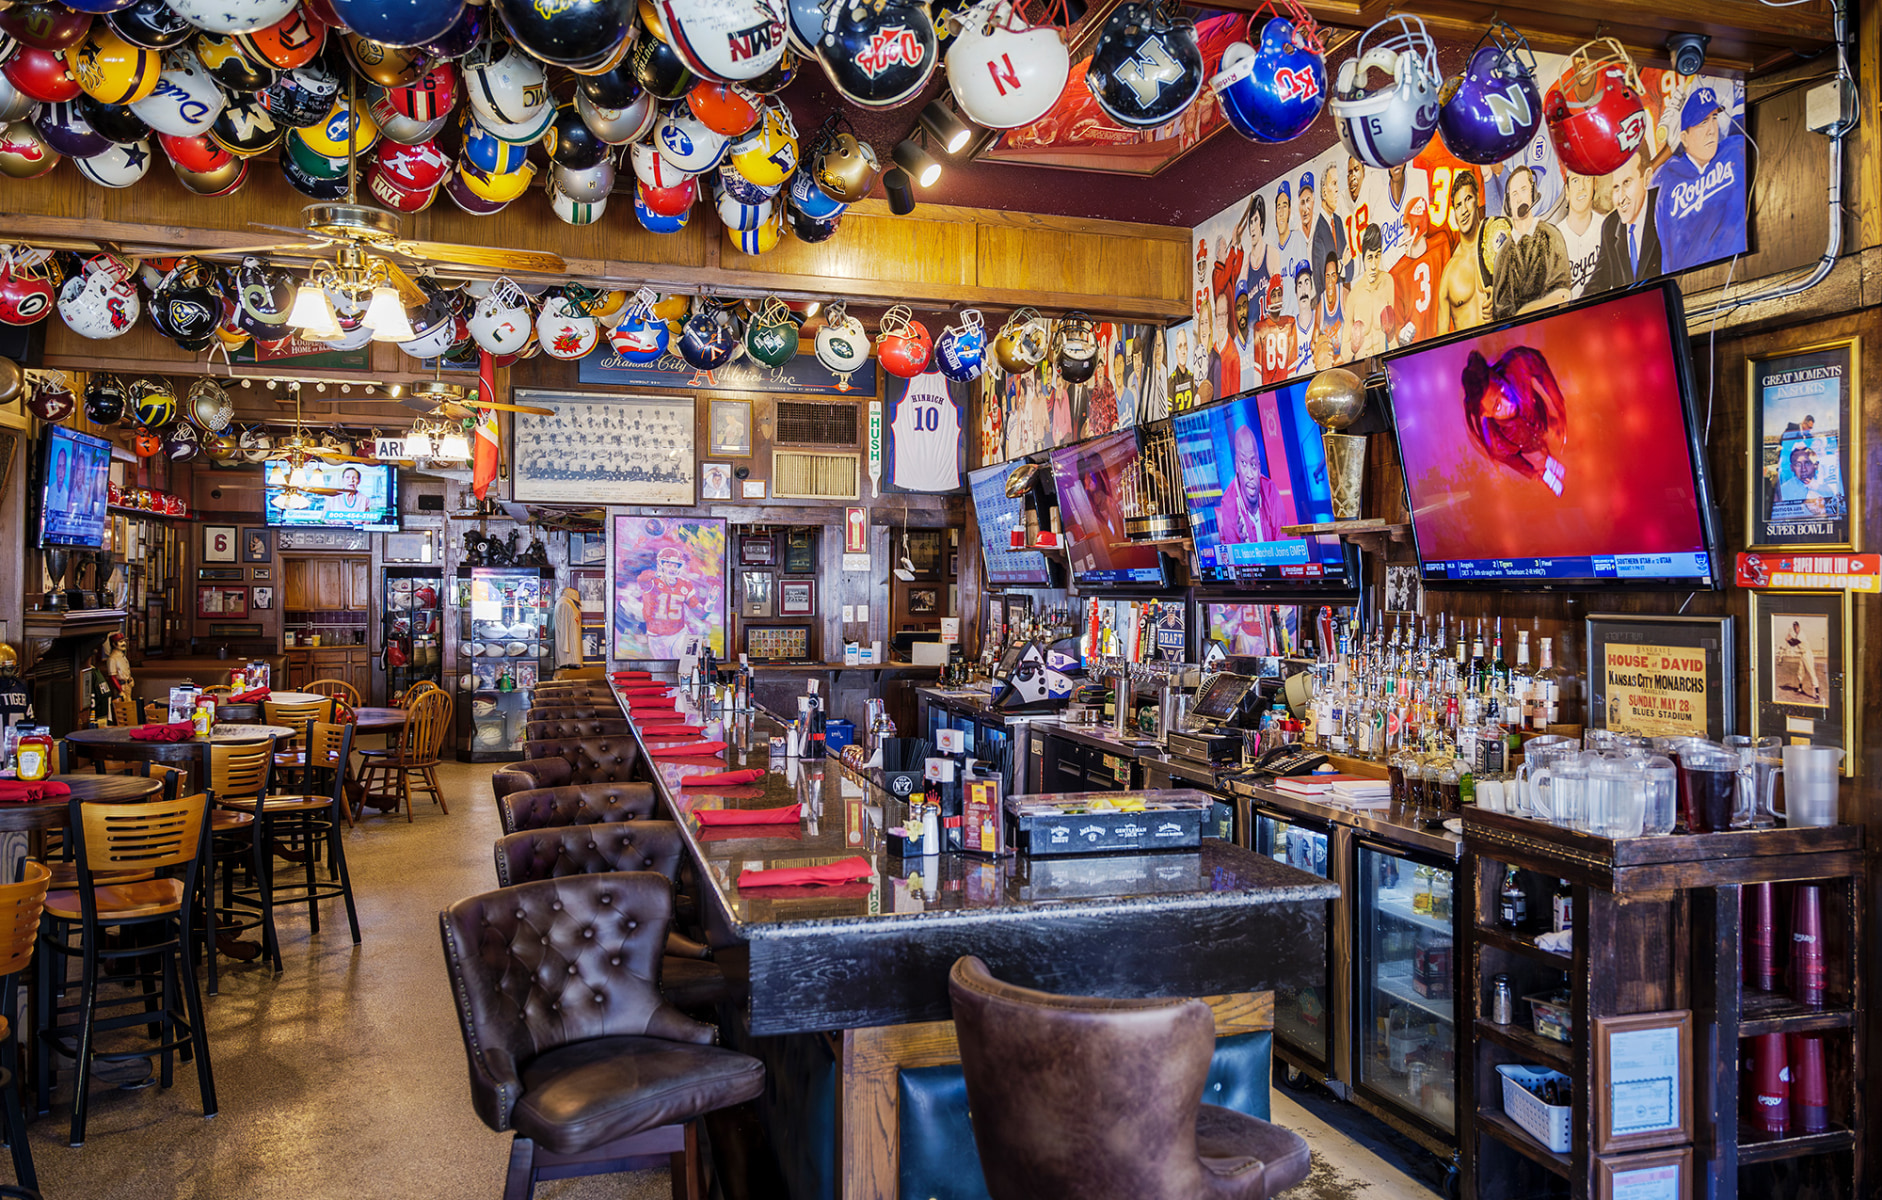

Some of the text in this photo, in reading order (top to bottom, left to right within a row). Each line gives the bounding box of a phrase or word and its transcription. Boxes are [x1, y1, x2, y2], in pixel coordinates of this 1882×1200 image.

[987, 53, 1021, 97] N
[1273, 64, 1320, 103] KU
[150, 77, 209, 124] Duke
[1484, 83, 1532, 136] N
[371, 176, 402, 208] VMI
[1670, 160, 1735, 219] Royals
[1345, 202, 1369, 259] 18
[1413, 261, 1432, 311] 3
[1266, 332, 1288, 372] 89
[657, 353, 687, 373] City
[1762, 364, 1842, 388] GREAT MOMENTS
[911, 393, 945, 406] HINRICH
[1777, 382, 1825, 398] IN SPORTS
[914, 405, 939, 432] 10
[870, 417, 880, 461] HUSH
[1766, 522, 1834, 536] SUPER BOWL II
[214, 533, 228, 552] 6
[1290, 545, 1307, 556] GMFB
[1499, 560, 1514, 568] Tigers
[1793, 557, 1813, 573] SUPER
[1814, 557, 1833, 573] BOWL
[1772, 572, 1872, 590] CHAMPIONS
[656, 593, 686, 621] 15
[1160, 632, 1183, 645] DRAFT
[1608, 654, 1648, 668] HOUSE
[1661, 657, 1704, 672] DAVID
[1608, 670, 1704, 693] KANSAS CITY MONARCHS
[26, 703, 35, 719] 4
[1632, 707, 1692, 721] BLUES STADIUM
[1660, 697, 1677, 711] MAY
